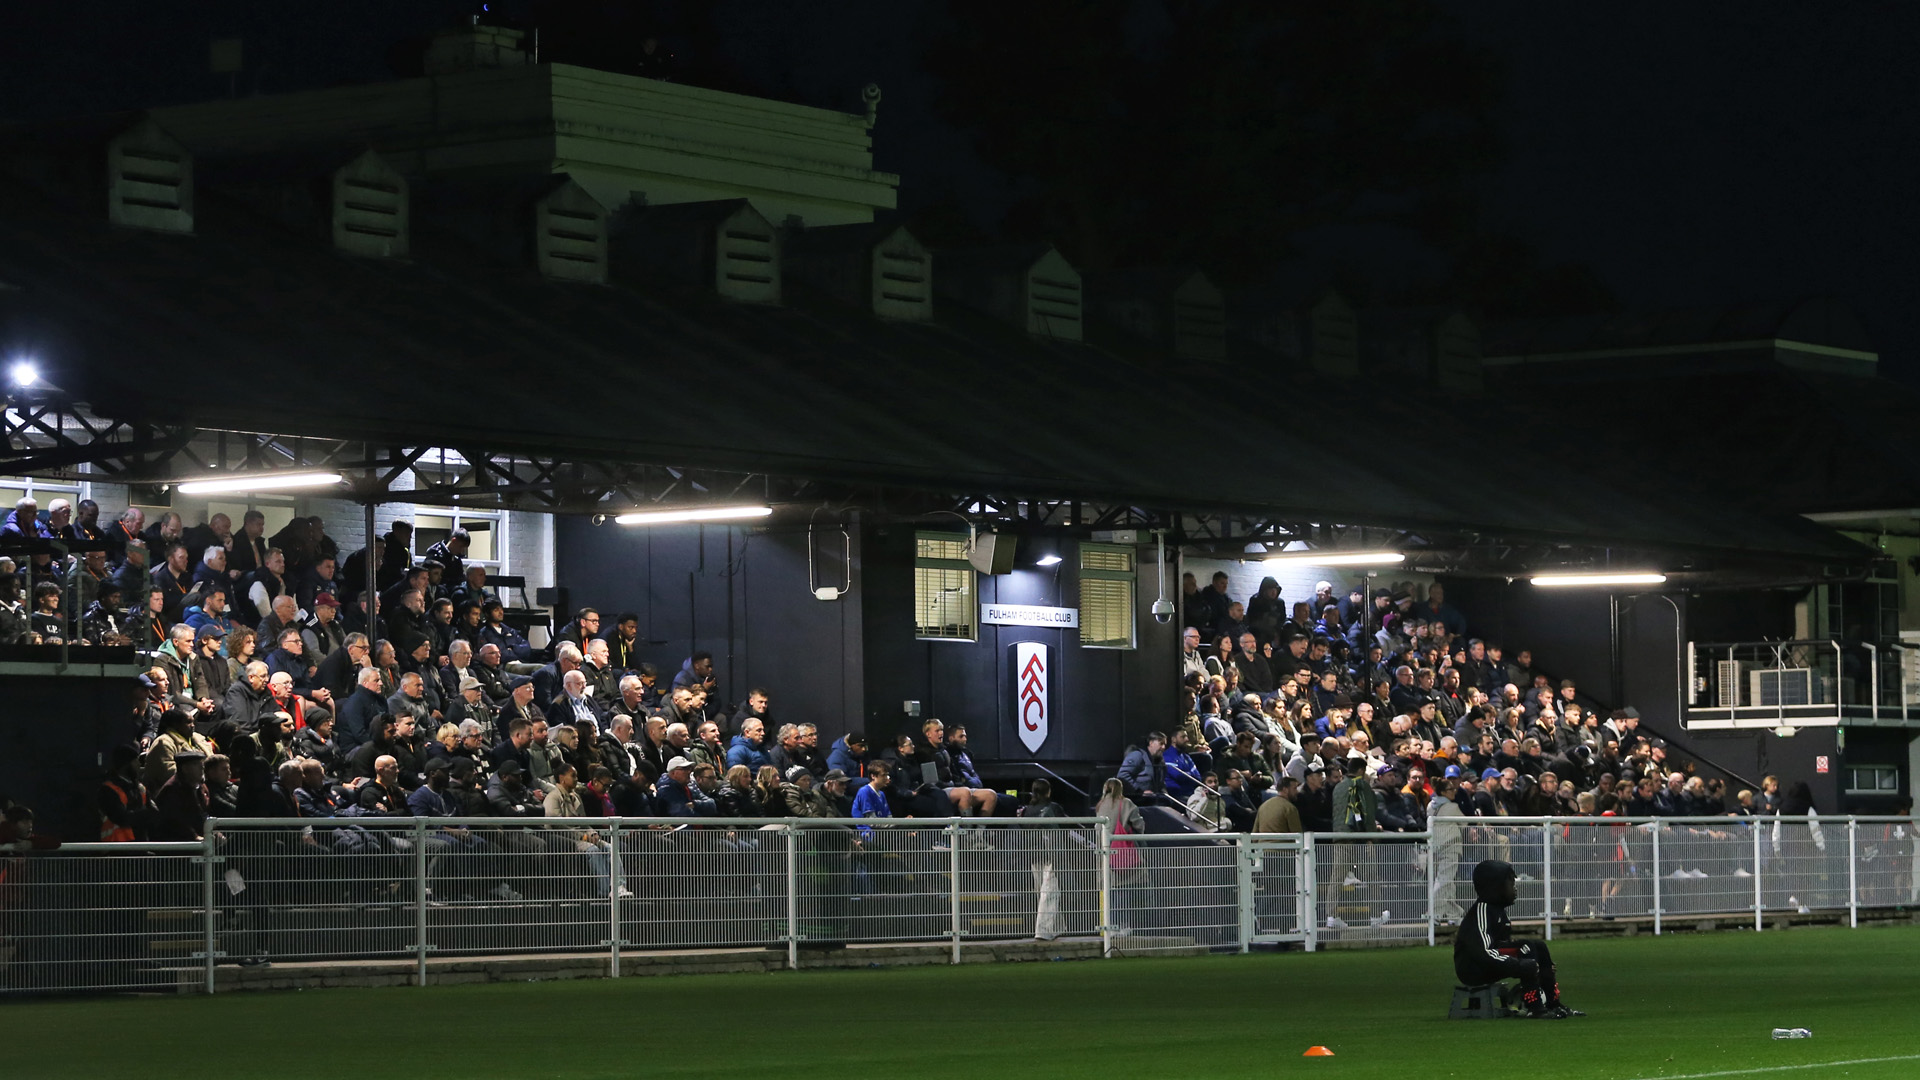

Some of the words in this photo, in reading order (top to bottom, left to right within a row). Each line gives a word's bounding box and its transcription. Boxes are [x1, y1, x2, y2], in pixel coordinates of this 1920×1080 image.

[989, 609, 1017, 619] FULHAM
[1019, 611, 1053, 622] FOOTBALL
[1055, 613, 1072, 622] CLUB
[1021, 653, 1044, 731] FFC
